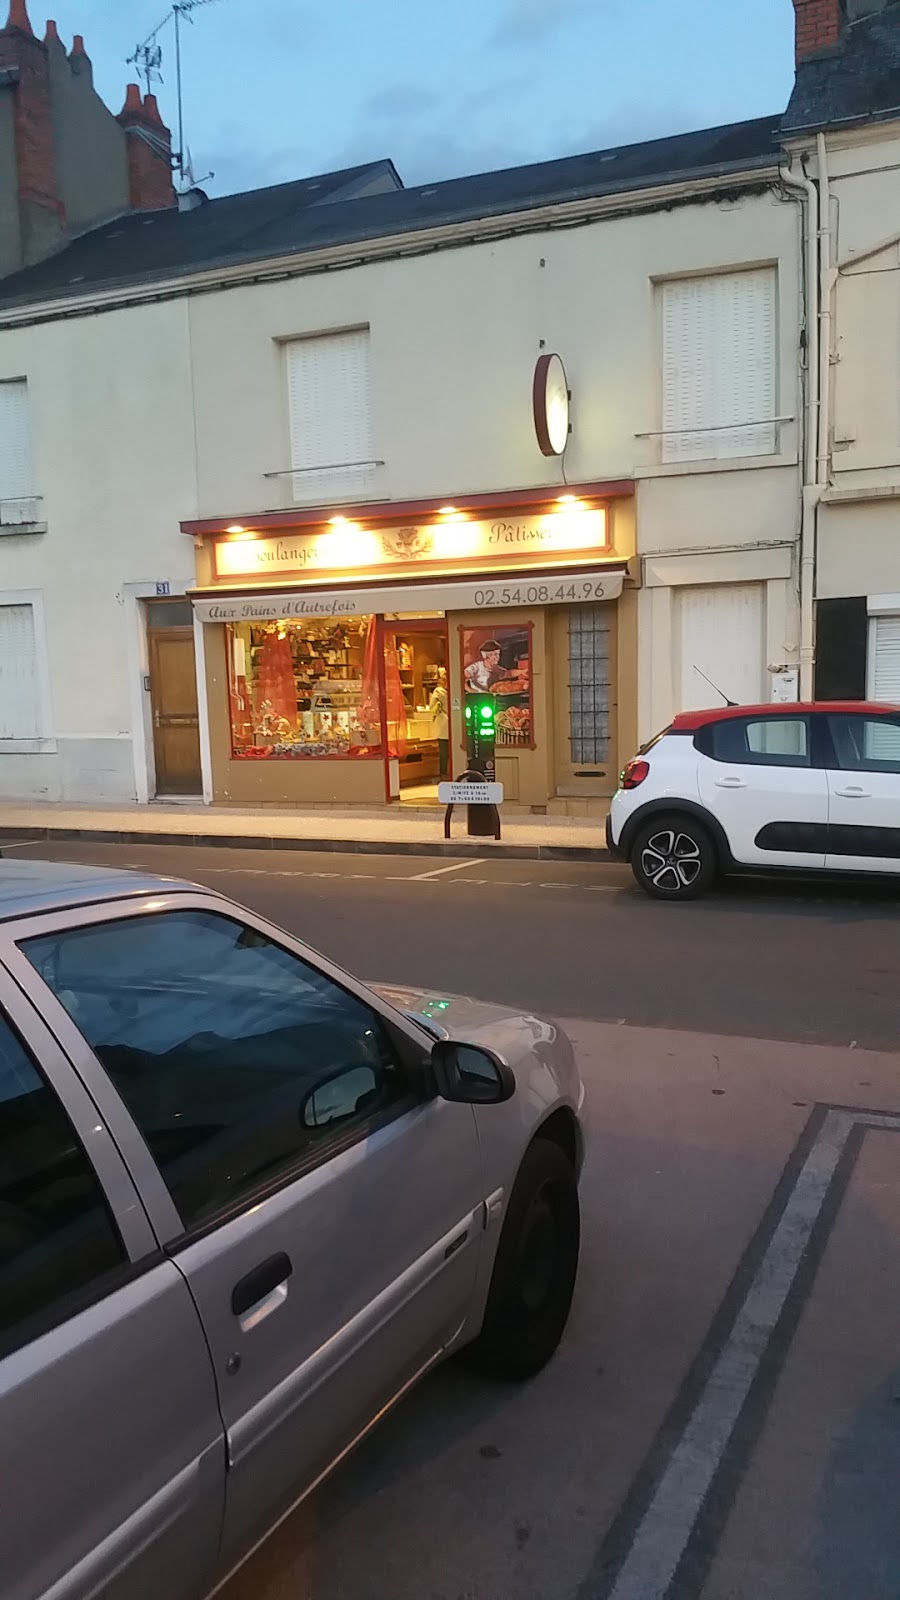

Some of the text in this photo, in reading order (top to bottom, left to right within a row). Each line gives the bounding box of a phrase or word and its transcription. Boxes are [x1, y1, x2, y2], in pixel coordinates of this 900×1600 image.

[488, 521, 553, 544] Pâtisse
[157, 584, 168, 594] 31
[474, 582, 605, 606] 02.54.08.44.96
[208, 600, 356, 618] Aux Pains d'Autrefois
